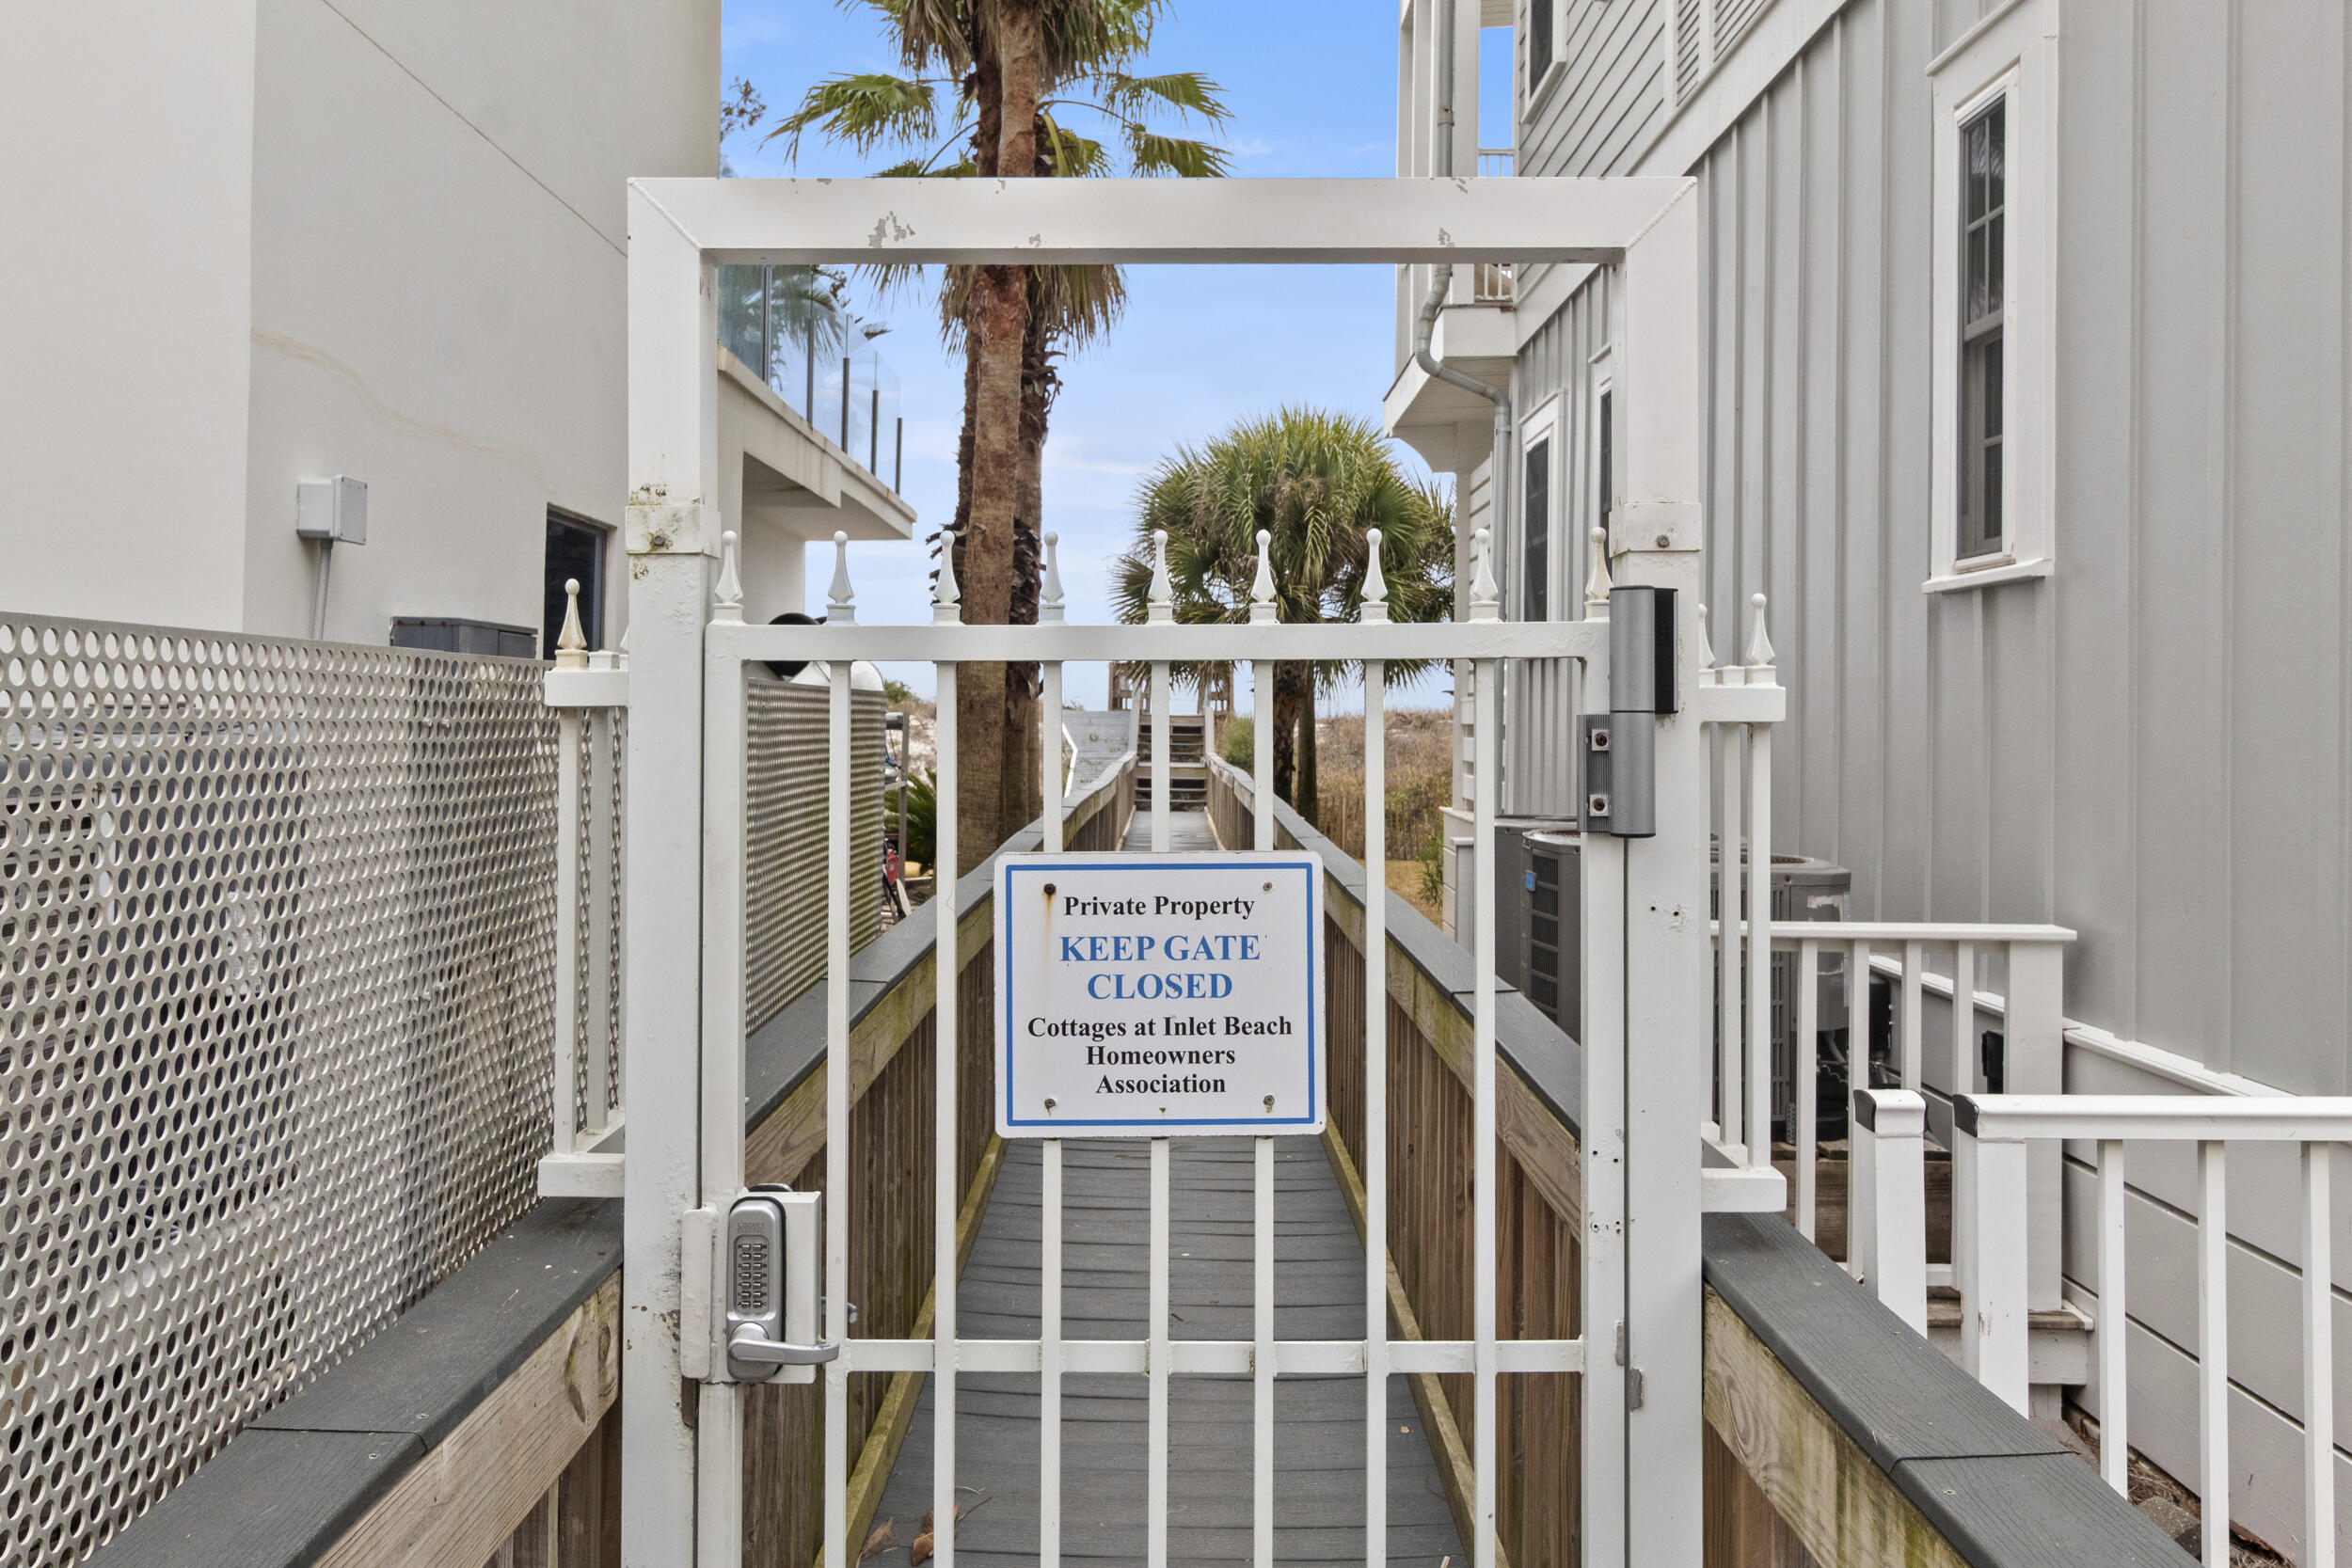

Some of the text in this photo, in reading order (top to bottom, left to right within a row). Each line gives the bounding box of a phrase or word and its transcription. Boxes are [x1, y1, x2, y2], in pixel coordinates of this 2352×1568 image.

[1064, 895, 1255, 920] Private Property
[1059, 935, 1261, 961] KEEP GATE
[1087, 973, 1233, 999] CLOSED
[1027, 1016, 1293, 1041] Cottages at Inlet Beach
[1086, 1046, 1236, 1066] Homeowners
[1096, 1073, 1226, 1094] Association
